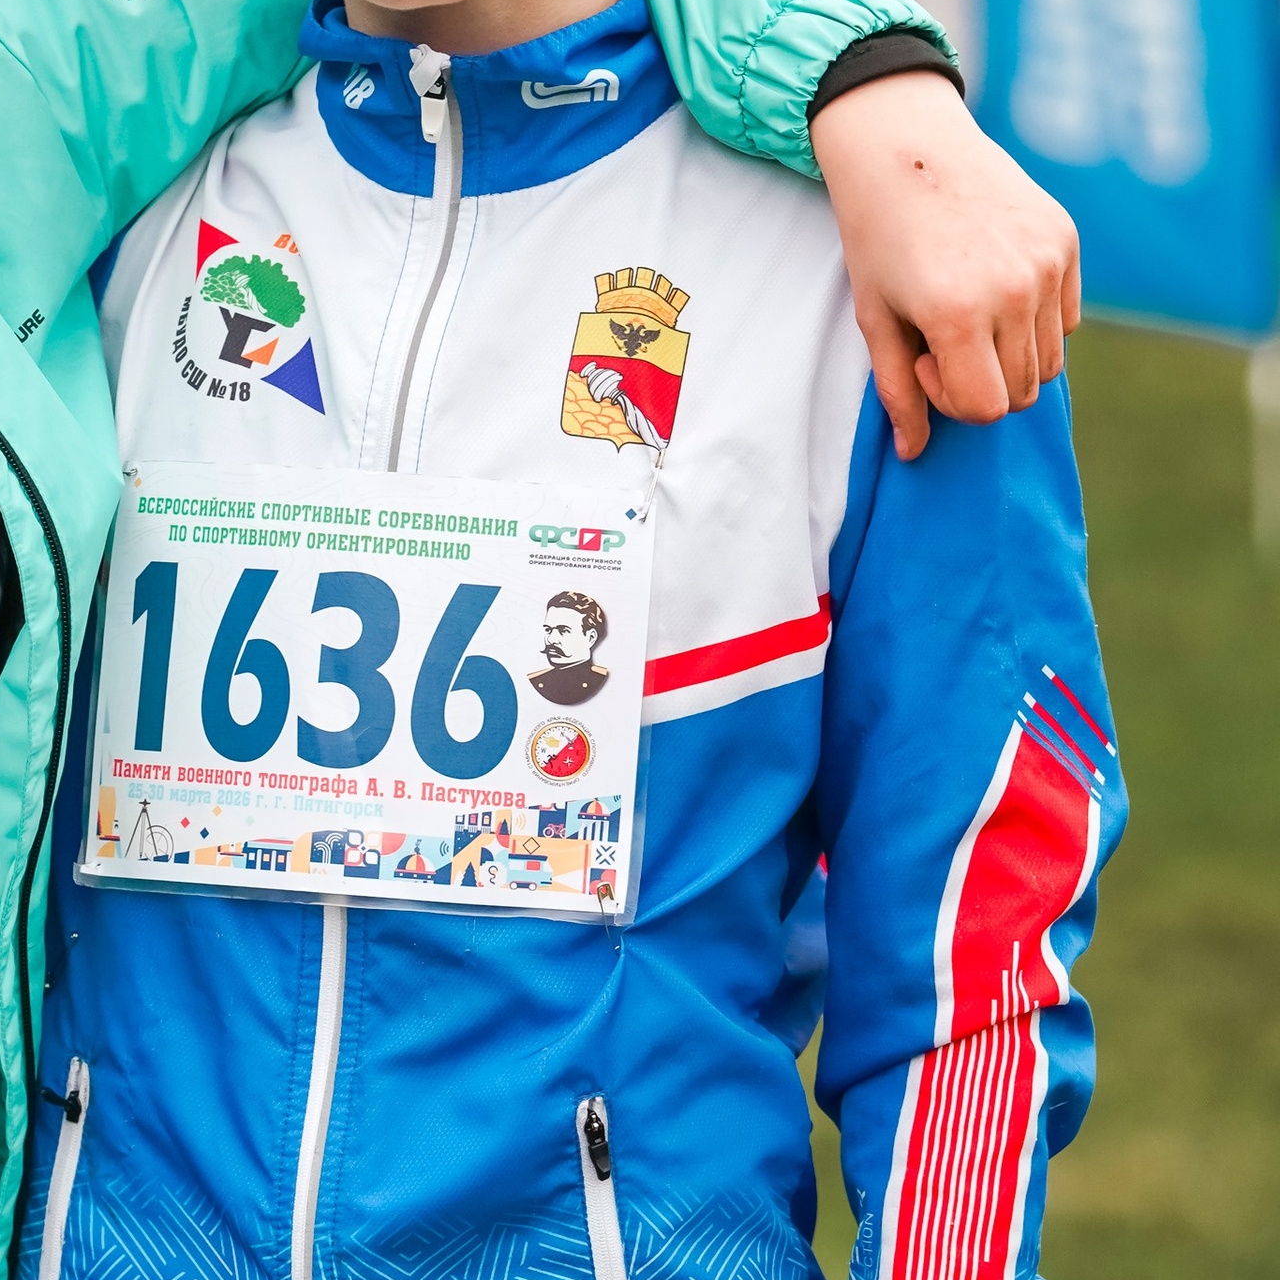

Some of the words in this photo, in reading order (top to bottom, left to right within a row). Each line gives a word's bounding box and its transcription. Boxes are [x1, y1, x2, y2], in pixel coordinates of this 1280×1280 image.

[181, 359, 208, 391] СШ
[206, 378, 251, 402] №18
[138, 496, 256, 519] ВСЕРОССИЙСКИЕ
[261, 502, 371, 526] СПОРТИВНЫЕ
[378, 509, 519, 537] СОРЕВНОВАНИЯ
[168, 524, 187, 542] ПО
[192, 525, 302, 549] СПОРТИВНОМУ
[306, 532, 472, 561] ОРИЕНТИРОВАНИЮ
[528, 553, 570, 562] ФЕДЕРАЦИЯ
[571, 556, 622, 565] СПОРТИВНОГО
[528, 559, 592, 570] ОРИЕНТИРОВАНИЯ
[592, 564, 622, 572] РОССИИ
[131, 560, 519, 781] 1636
[112, 758, 171, 781] Памяти
[177, 766, 252, 787] военного
[258, 772, 358, 798] топографа
[365, 777, 384, 797] А.
[393, 780, 412, 799] В.
[420, 782, 526, 809] Пастухова
[127, 782, 165, 800] 25-30
[168, 786, 211, 807] марта
[215, 789, 251, 807] 2026
[255, 794, 268, 809] г.
[273, 795, 287, 810] г.
[292, 794, 384, 819] Пятигорск
